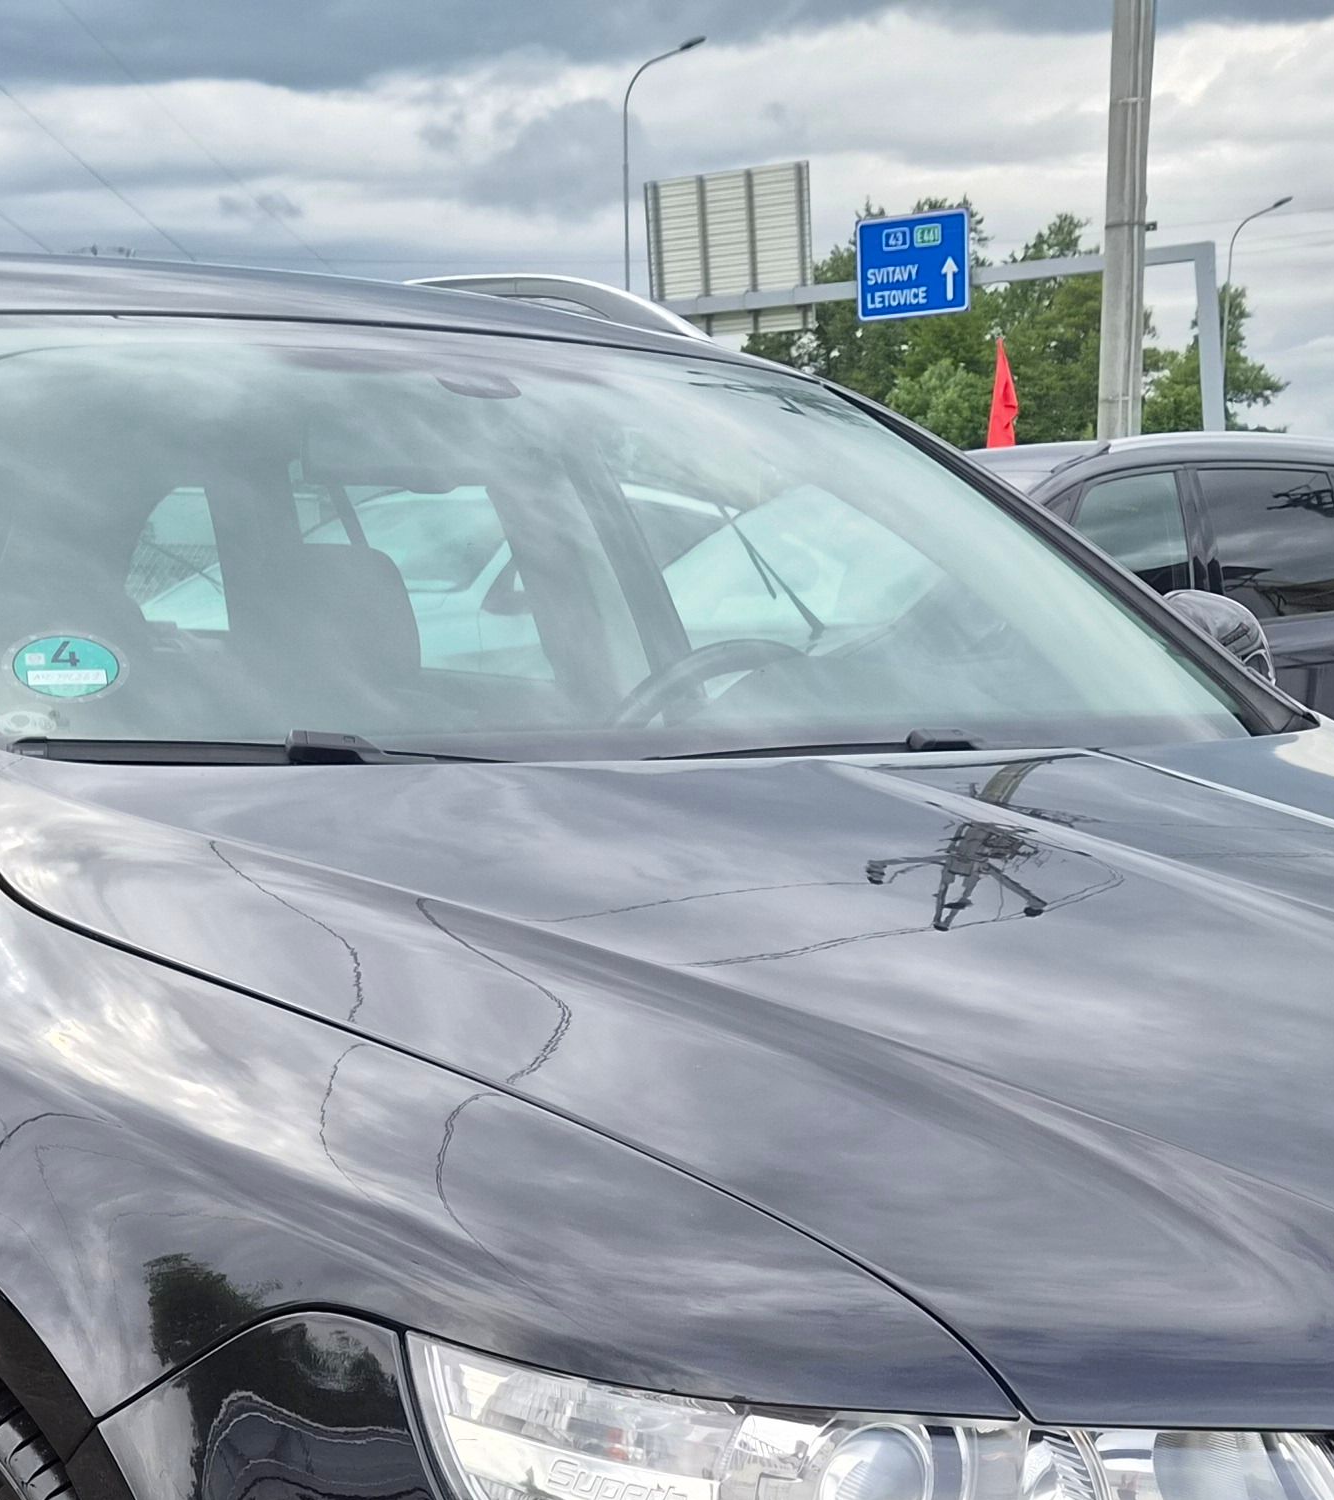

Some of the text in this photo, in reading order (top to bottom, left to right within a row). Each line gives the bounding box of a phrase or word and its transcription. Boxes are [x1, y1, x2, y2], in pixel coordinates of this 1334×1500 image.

[888, 231, 904, 247] 43
[867, 264, 919, 286] SVITAVY
[867, 286, 928, 309] LETOVICE
[50, 640, 80, 667] 4
